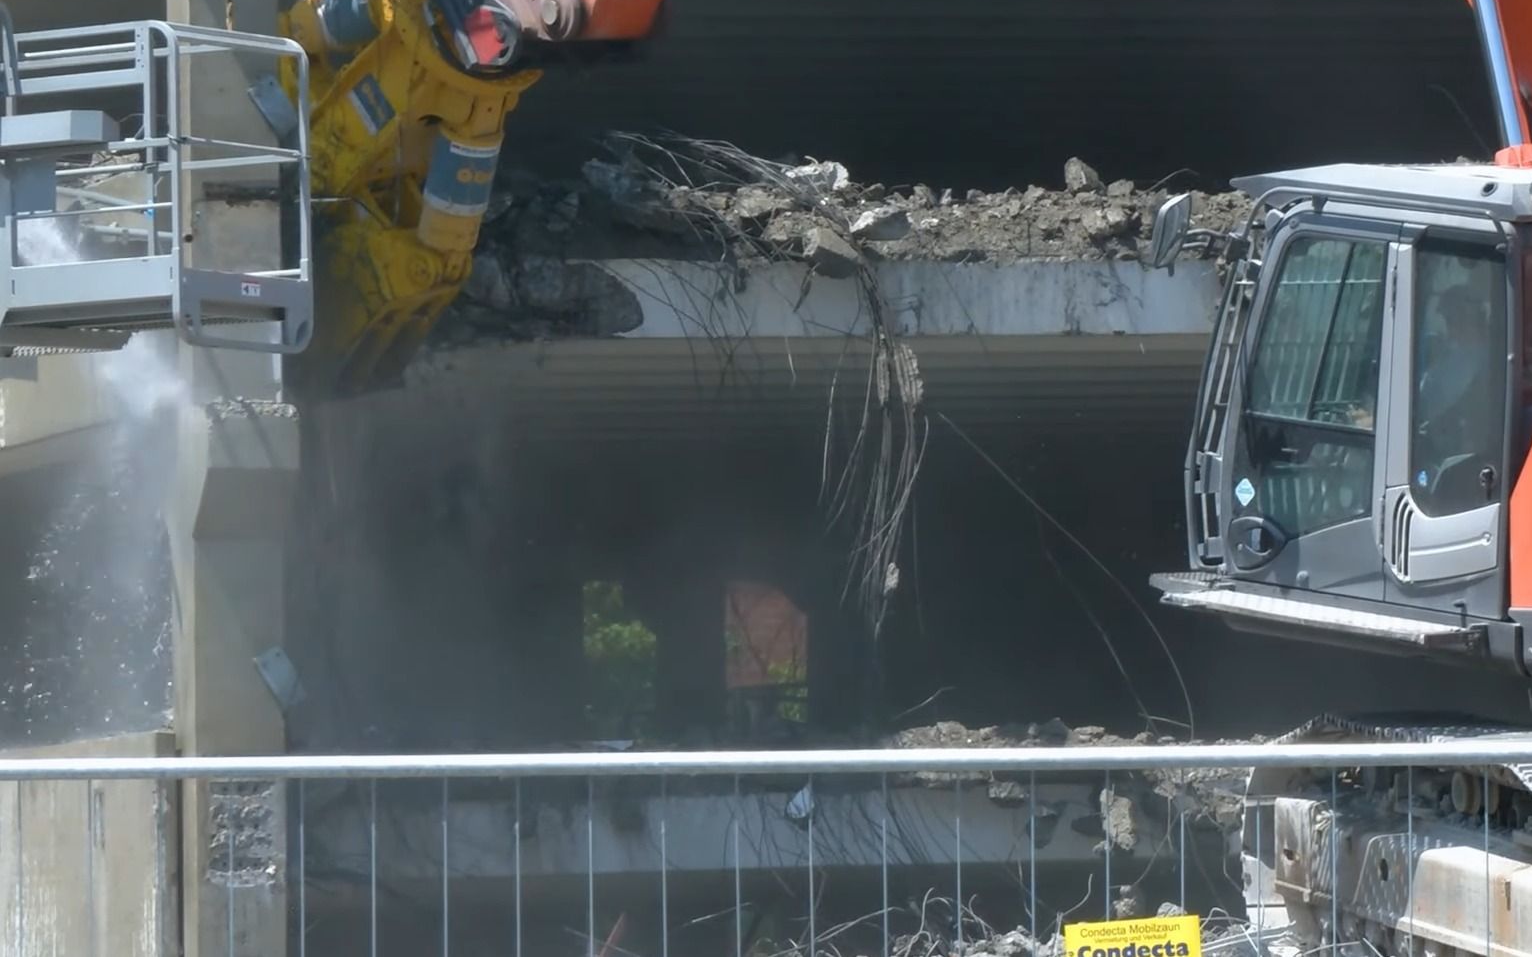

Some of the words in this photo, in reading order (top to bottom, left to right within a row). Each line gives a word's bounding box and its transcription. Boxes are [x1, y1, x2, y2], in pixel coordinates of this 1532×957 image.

[1080, 927, 1126, 938] Condecta
[1129, 923, 1181, 935] Mobilzaun
[1077, 940, 1189, 957] Condecta
